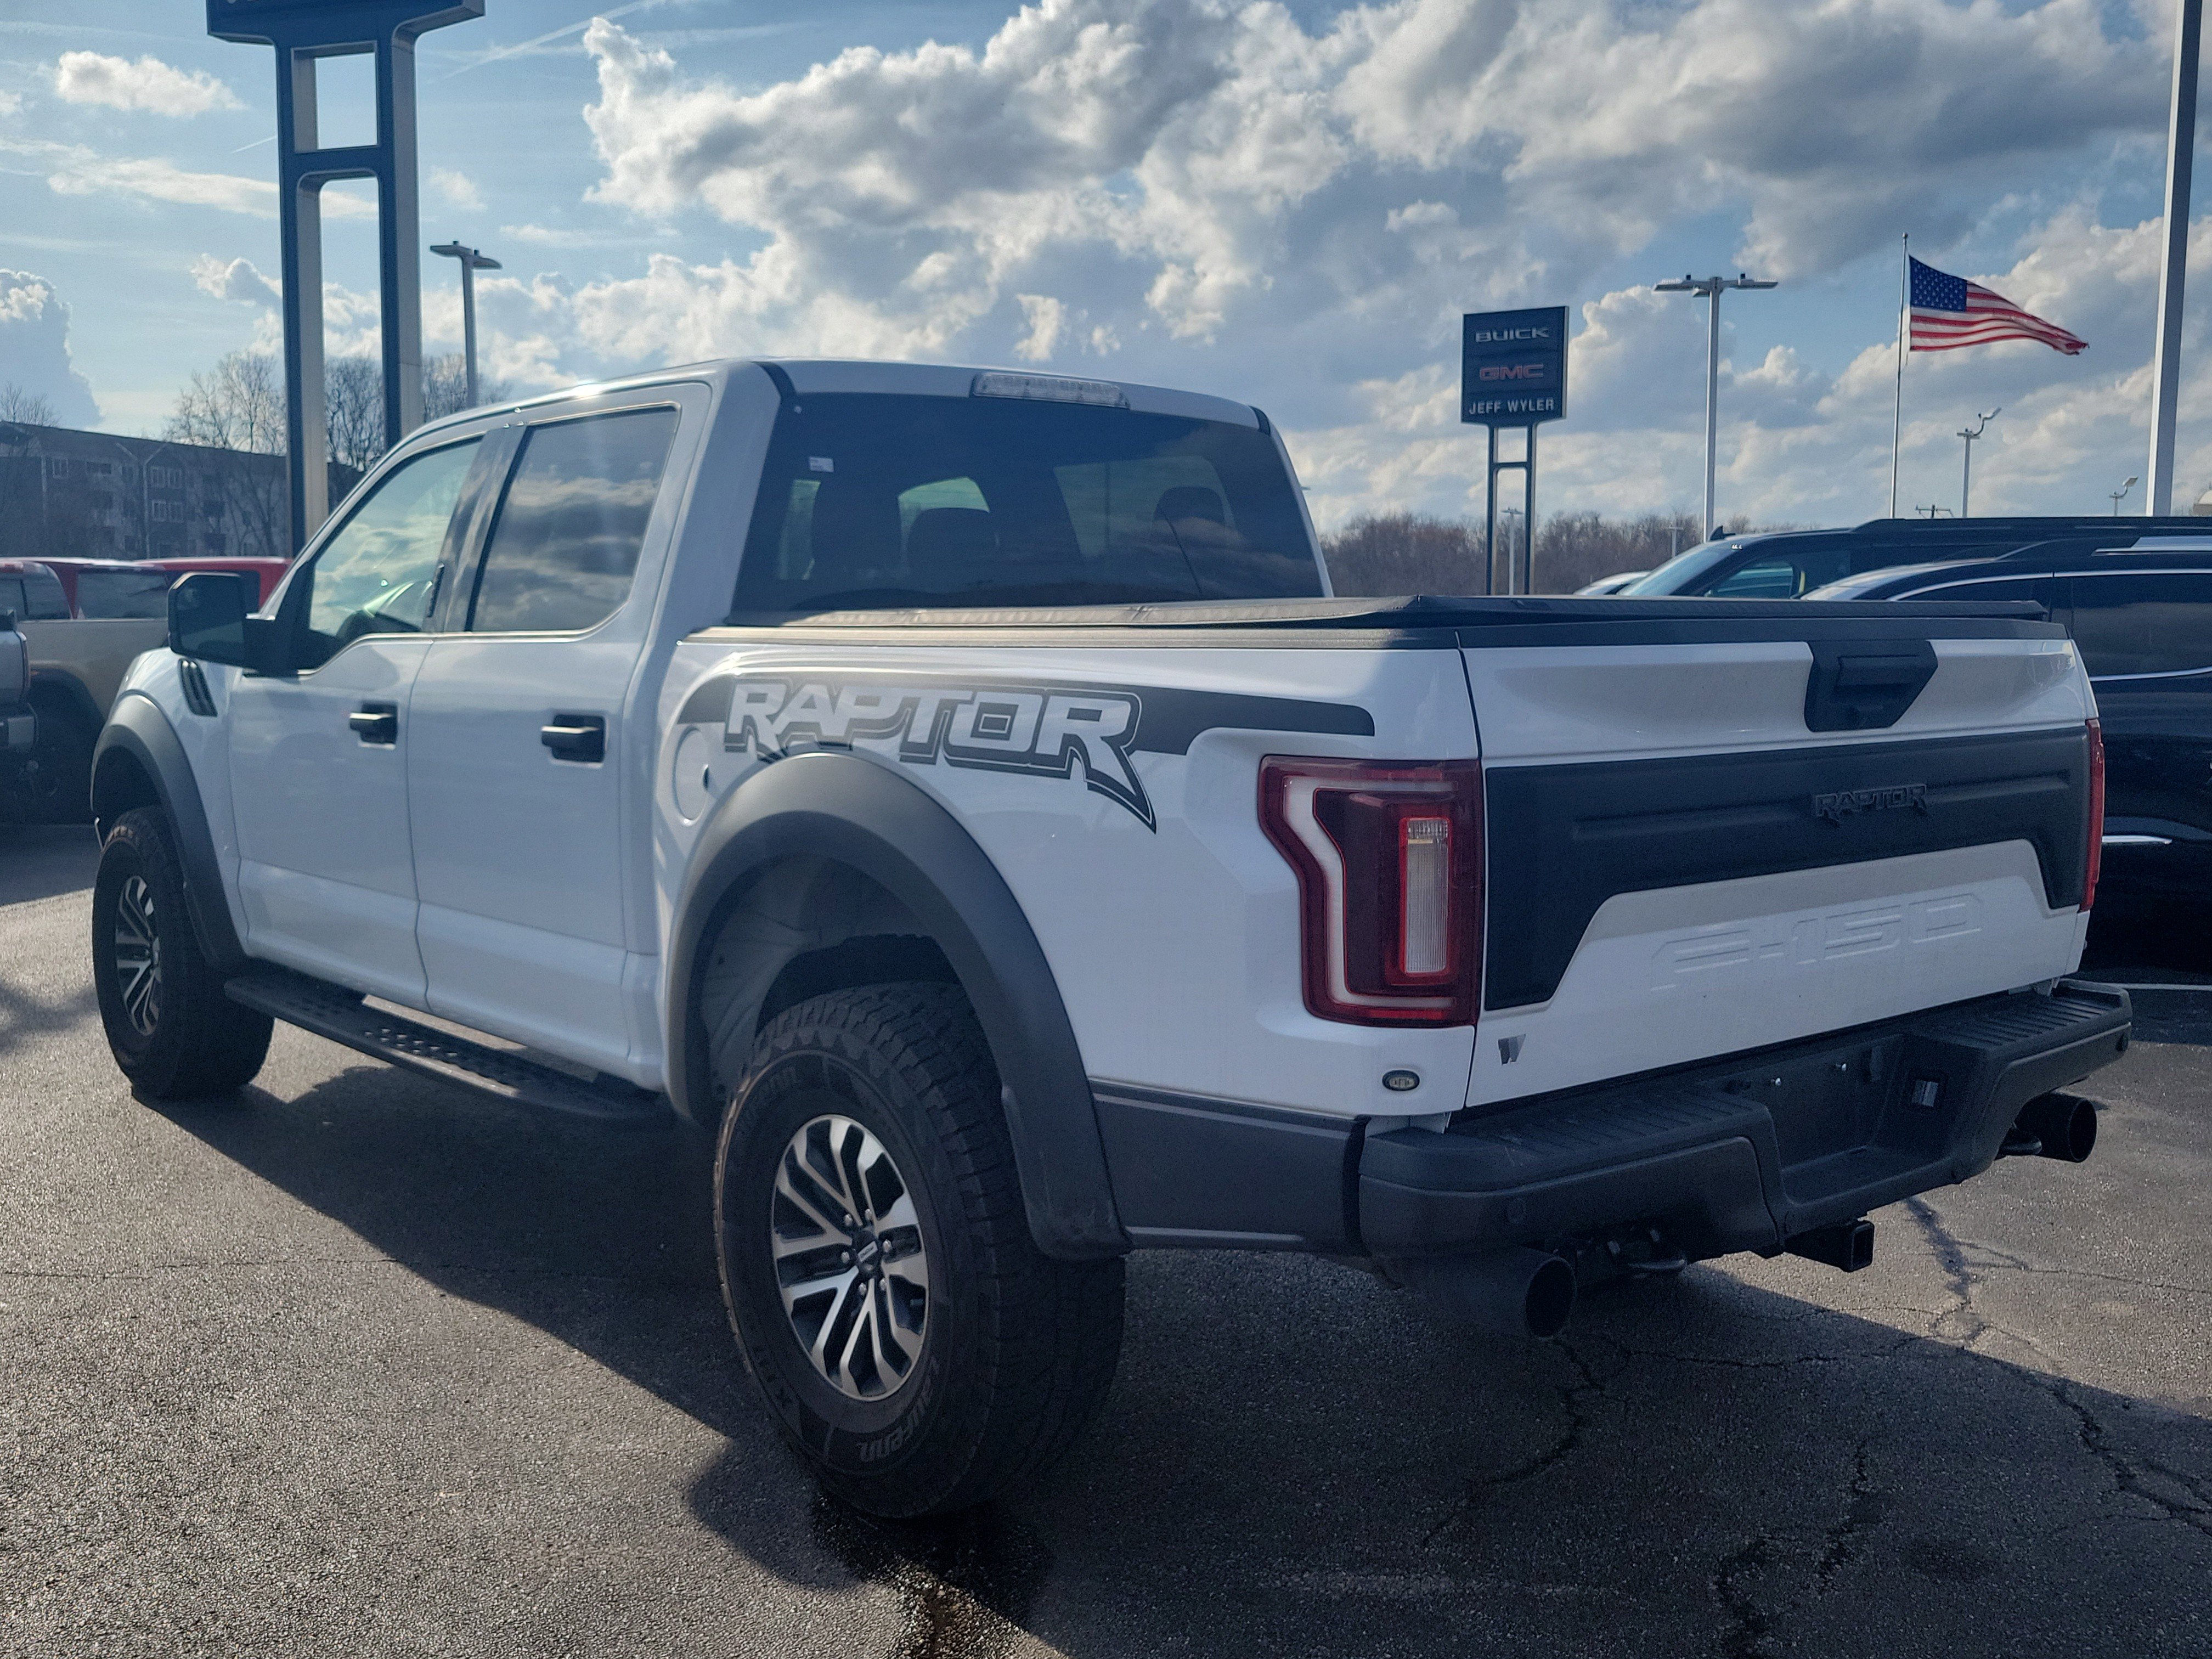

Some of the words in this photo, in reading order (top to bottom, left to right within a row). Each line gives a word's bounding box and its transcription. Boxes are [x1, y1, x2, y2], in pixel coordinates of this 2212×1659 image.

[1475, 328, 1549, 343] BUICK
[1480, 364, 1543, 381] GMC
[1469, 399, 1501, 415] JEFF
[1508, 397, 1554, 411] WYLER
[725, 677, 1156, 834] RAPTOR
[1815, 783, 1927, 823] RAPTOR
[1651, 893, 1983, 991] F-150
